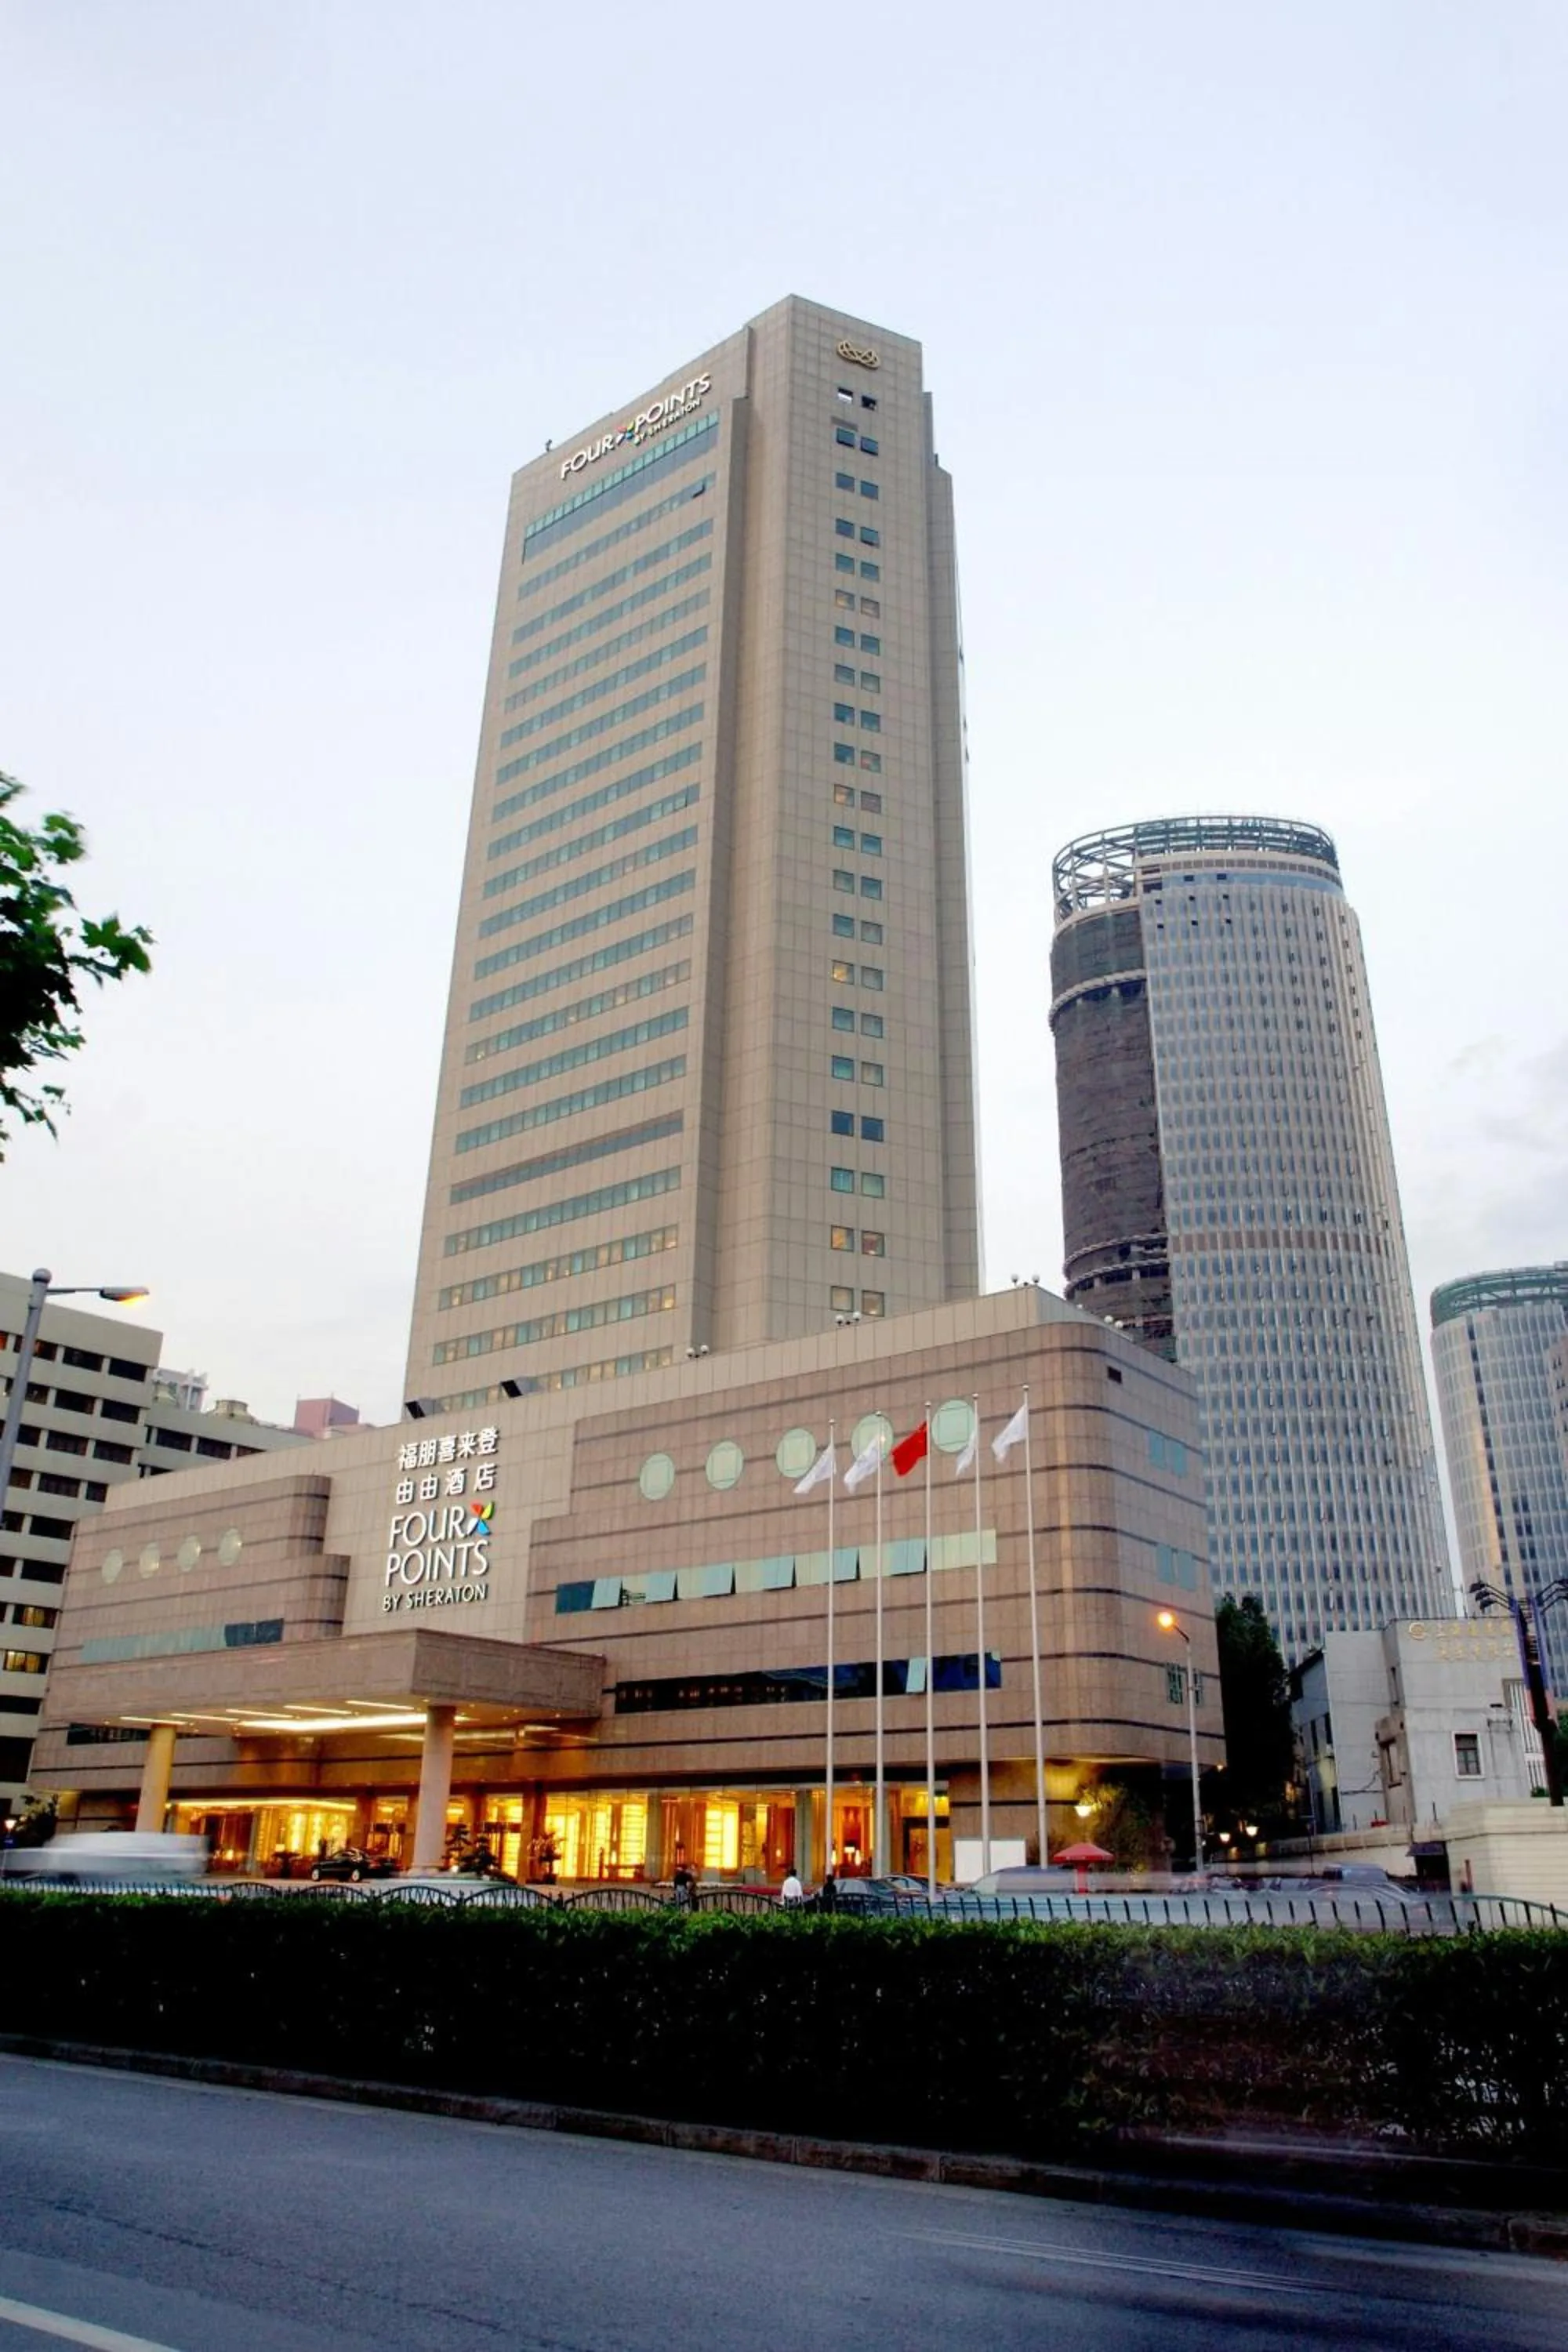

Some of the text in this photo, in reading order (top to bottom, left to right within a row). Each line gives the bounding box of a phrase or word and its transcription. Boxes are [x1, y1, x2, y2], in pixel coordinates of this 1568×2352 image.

[560, 372, 711, 480] FOUR POINTS
[397, 1426, 499, 1471] 福朋喜来登
[396, 1461, 497, 1505] 由由酒店
[389, 1505, 466, 1549] FOUR
[385, 1539, 488, 1587] POINTS
[383, 1584, 488, 1612] BY SHERATON
